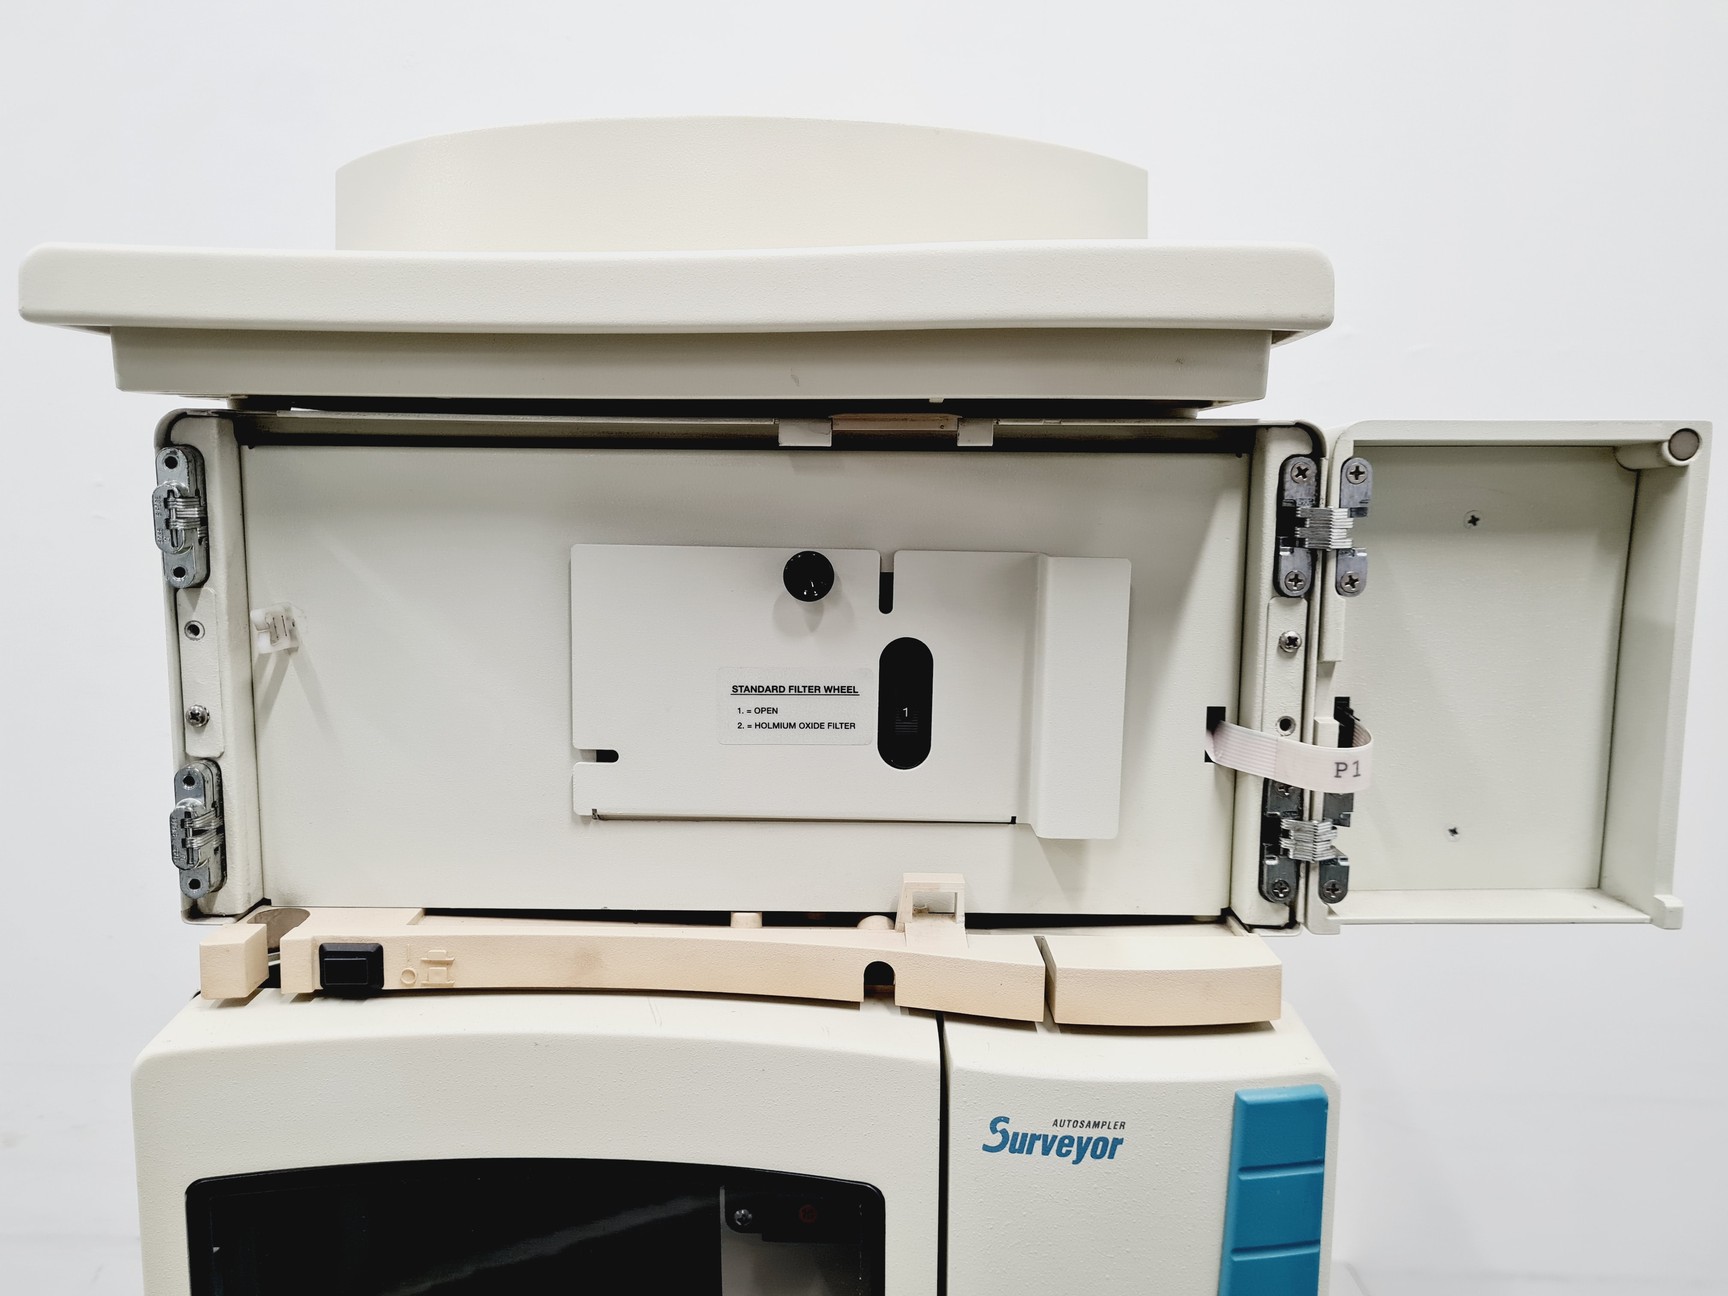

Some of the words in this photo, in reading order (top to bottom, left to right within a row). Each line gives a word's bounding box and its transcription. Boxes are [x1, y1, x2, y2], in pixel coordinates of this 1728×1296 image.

[732, 685, 786, 694] STANDARD
[788, 685, 821, 694] FILTER
[823, 686, 858, 694] WHEEL
[737, 707, 744, 715] 1.
[754, 707, 779, 715] OPEN
[902, 707, 909, 718] 1
[737, 722, 745, 730] 2.
[754, 722, 797, 730] HOLMIUM
[798, 722, 825, 730] OXIDE
[827, 722, 856, 730] FILTER
[1334, 760, 1361, 778] P1
[1052, 1118, 1126, 1130] AUTOSAMPLER
[982, 1116, 1124, 1165] Surveyor
